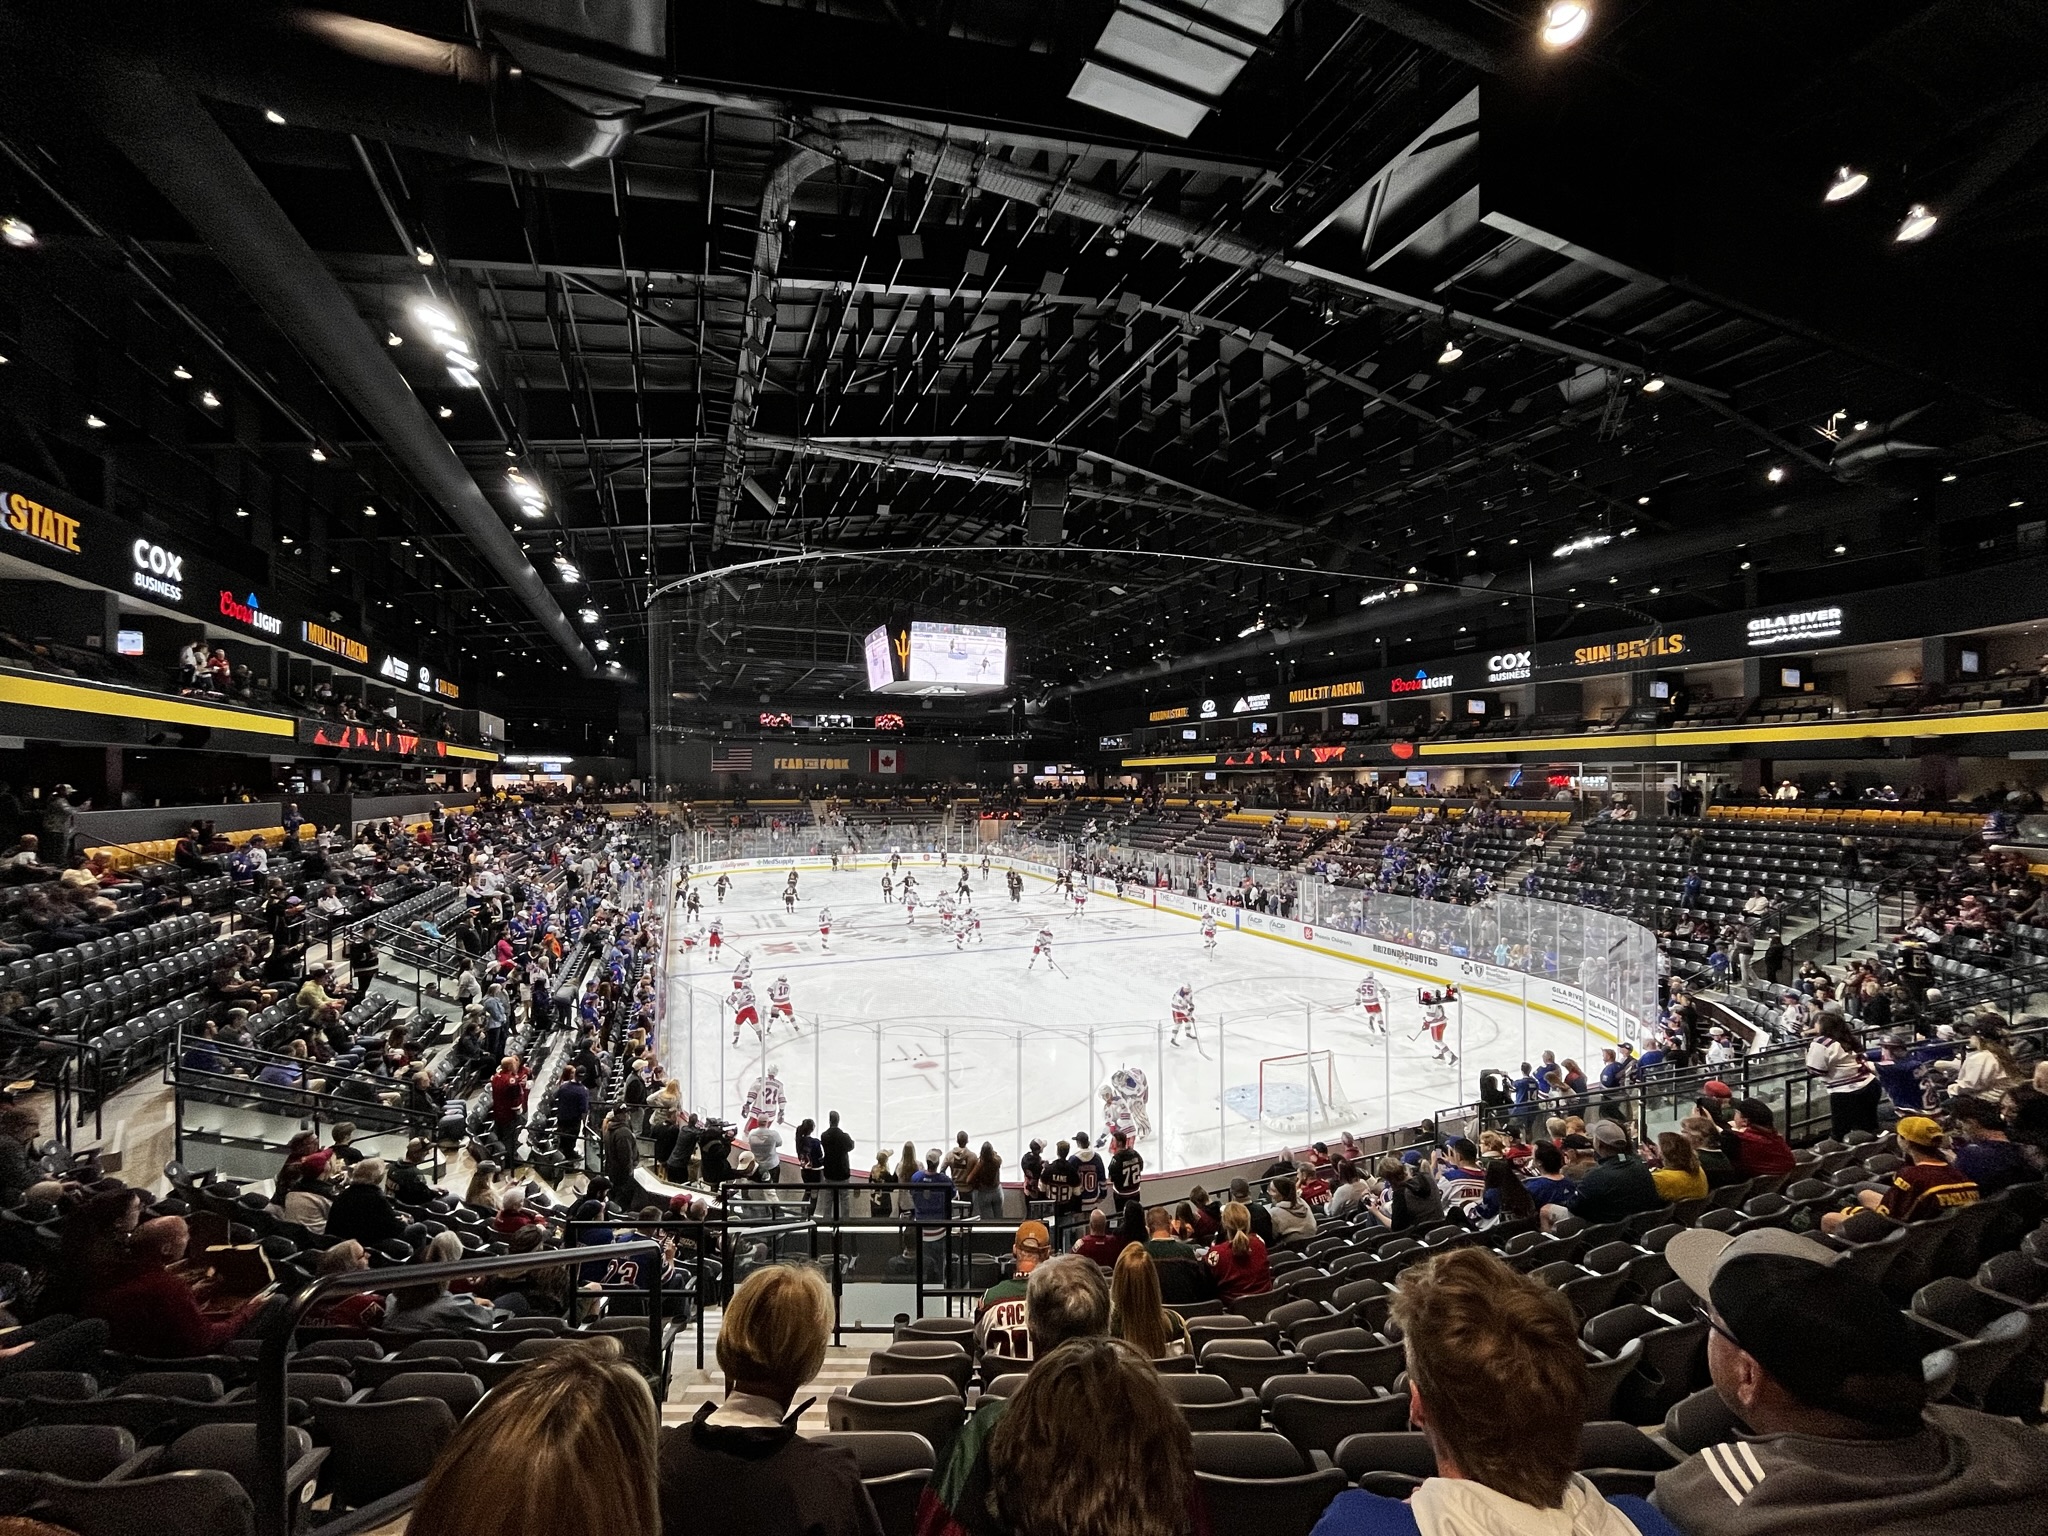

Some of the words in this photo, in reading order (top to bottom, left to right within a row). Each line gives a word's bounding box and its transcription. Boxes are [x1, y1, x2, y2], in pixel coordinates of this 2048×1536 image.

[9, 493, 82, 553] STATE
[133, 538, 183, 582] COX
[134, 571, 183, 601] BUSINESS
[220, 590, 253, 624] Coors
[253, 610, 282, 635] LIGHT
[1747, 617, 1786, 630] GILA
[1788, 608, 1842, 625] RIVER
[308, 621, 346, 653] MULLETT
[346, 638, 368, 663] ARENA
[1574, 644, 1611, 665] SUN
[1617, 634, 1683, 660] DEVILS
[1488, 650, 1531, 671] COX
[1391, 678, 1421, 693] Coors
[1421, 674, 1454, 689] LIGHT
[1488, 669, 1531, 682] BUSINESS
[1289, 685, 1330, 703] MULLETT
[1331, 681, 1362, 698] ARENA
[774, 758, 803, 770] FEAR
[820, 758, 849, 770] FORK
[1192, 902, 1208, 911] THE
[1211, 905, 1227, 918] KEG
[1404, 951, 1438, 967] COYOTES
[1361, 984, 1375, 995] 55
[1552, 986, 1567, 996] GILA
[1589, 999, 1601, 1009] GILA
[764, 1087, 778, 1104] 21
[1122, 1163, 1141, 1188] 72
